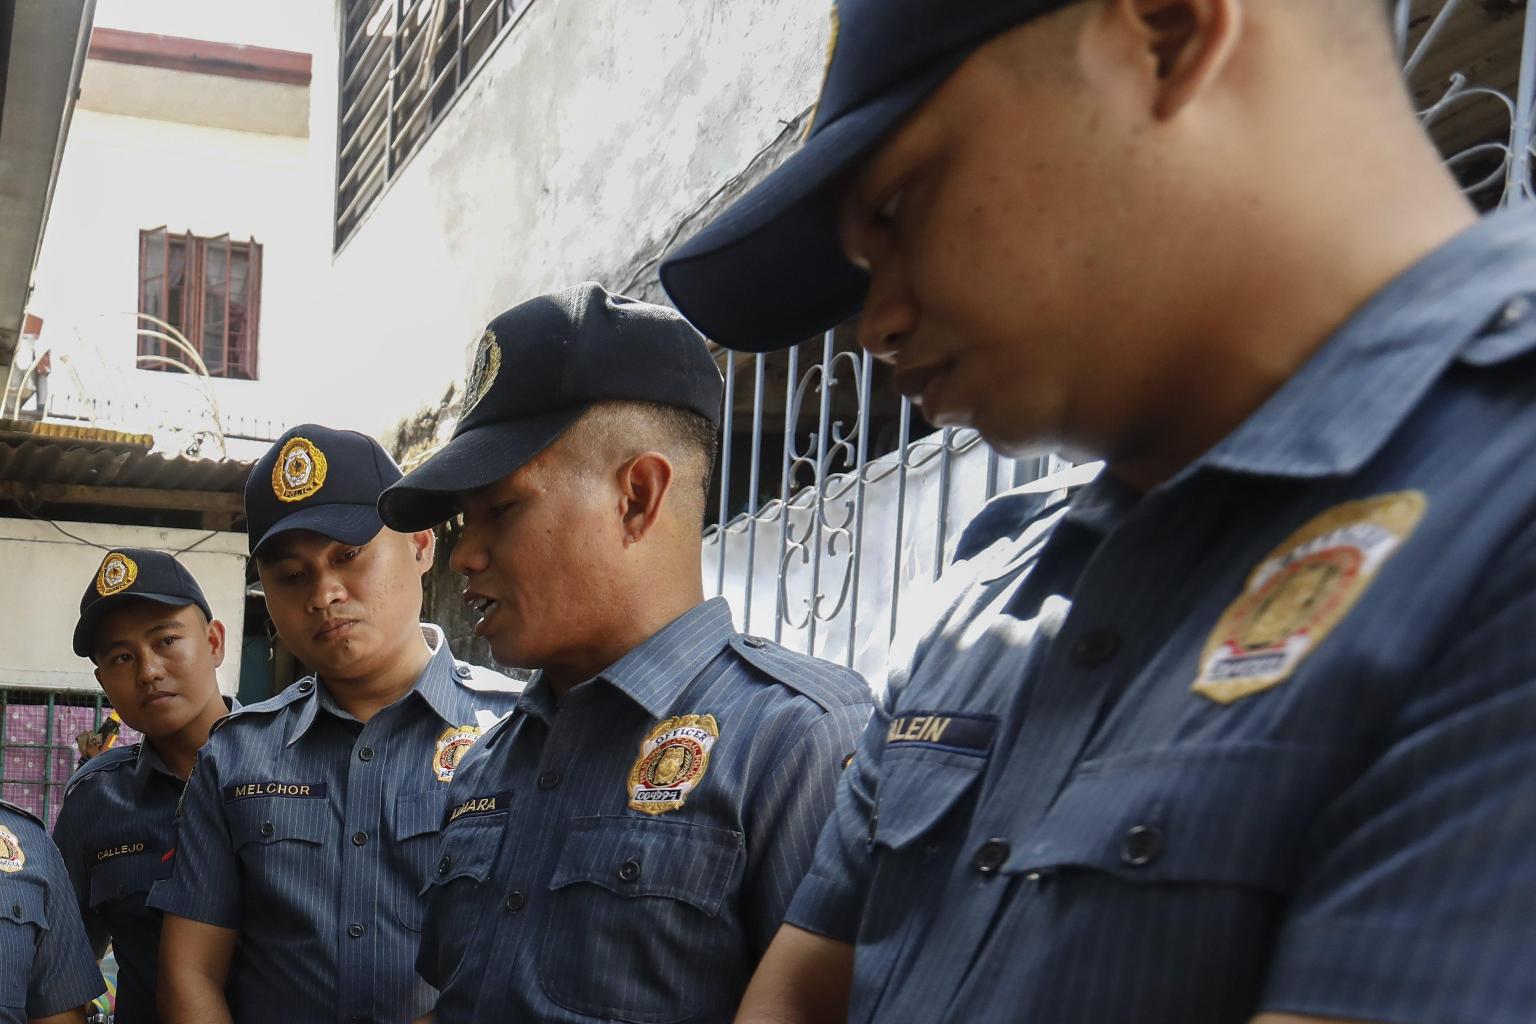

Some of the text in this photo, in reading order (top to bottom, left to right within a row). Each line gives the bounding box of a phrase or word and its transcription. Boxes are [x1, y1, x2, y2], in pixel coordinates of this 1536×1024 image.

[655, 728, 708, 745] OFFICER
[235, 782, 310, 798] MELCHOR
[97, 842, 145, 861] CALLEJO
